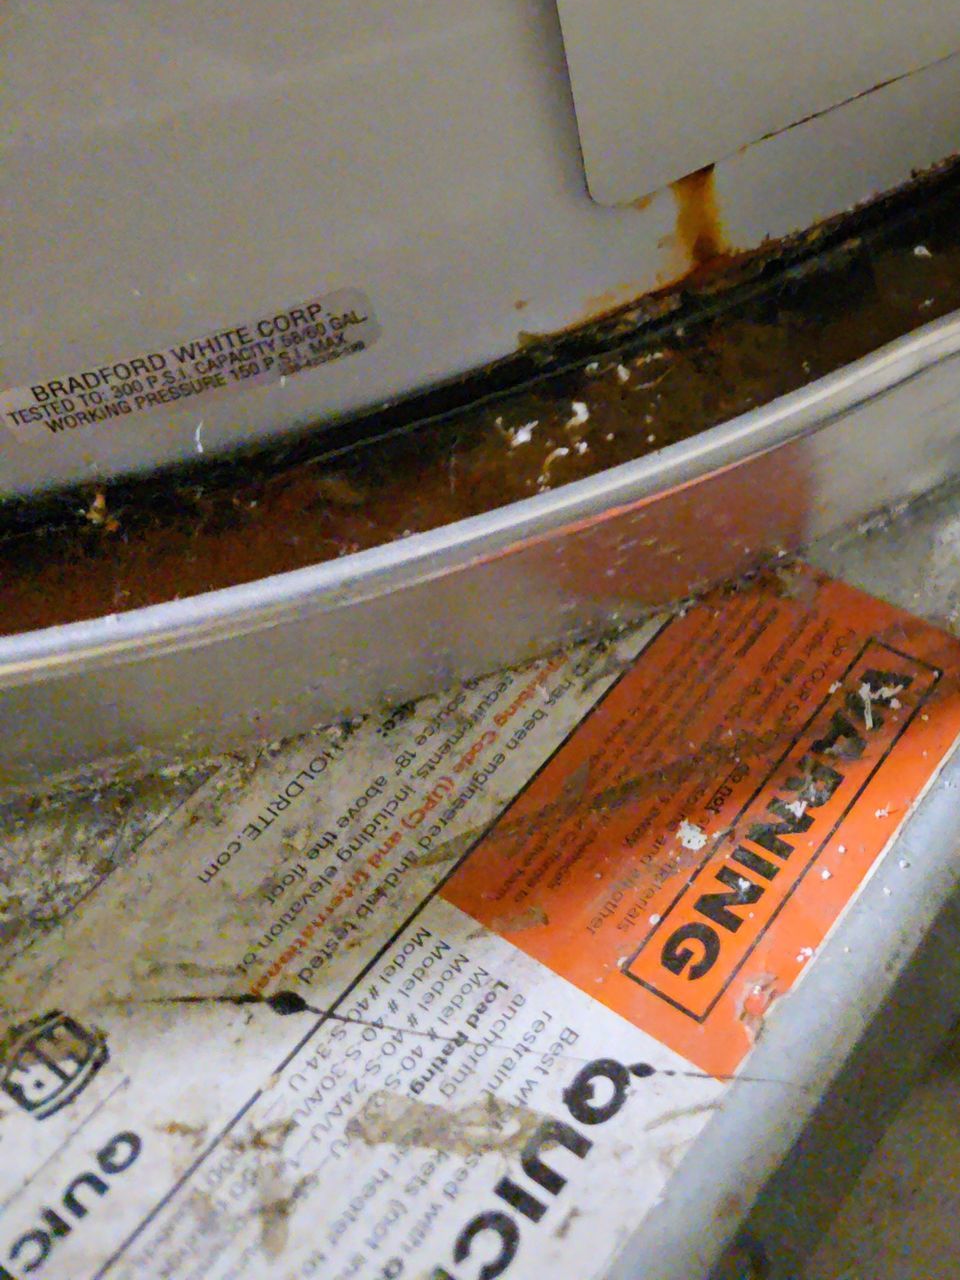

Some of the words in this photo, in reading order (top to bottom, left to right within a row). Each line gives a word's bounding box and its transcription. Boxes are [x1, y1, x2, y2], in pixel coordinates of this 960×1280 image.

[7, 400, 76, 427] TESTED
[77, 391, 104, 410] TO:
[113, 380, 145, 401] 300
[196, 338, 276, 376] CAPACITY
[31, 353, 166, 403] BRADFORD
[170, 327, 253, 364] WHITE
[256, 303, 333, 338] CORP.
[44, 400, 132, 434] WORKING
[136, 372, 226, 411] PRESSURE
[230, 363, 261, 383] 150
[308, 332, 348, 356] MAX
[412, 690, 468, 748] source
[543, 677, 576, 708] has
[451, 727, 499, 777] Code
[503, 705, 549, 753] been
[333, 773, 390, 832] above
[398, 773, 458, 833] (UPC)
[415, 747, 510, 852] engineered
[704, 783, 737, 818] not
[727, 760, 752, 788] do
[303, 829, 339, 864] the
[333, 783, 415, 864] including
[365, 829, 405, 870] and
[652, 652, 914, 991] WARNING
[382, 849, 420, 889] and
[256, 863, 341, 952] elevation
[582, 887, 628, 940] other
[295, 919, 359, 986] tested
[376, 924, 432, 986] Model
[396, 937, 452, 1000] Model
[415, 950, 469, 1013] Model
[435, 964, 490, 1027] Model
[464, 978, 509, 1030] Load
[436, 989, 531, 1104] anchoring
[477, 1008, 556, 1104] restraint
[532, 1025, 580, 1079] Best
[430, 1055, 638, 1280] QUIC
[0, 1130, 145, 1280] QUIC
